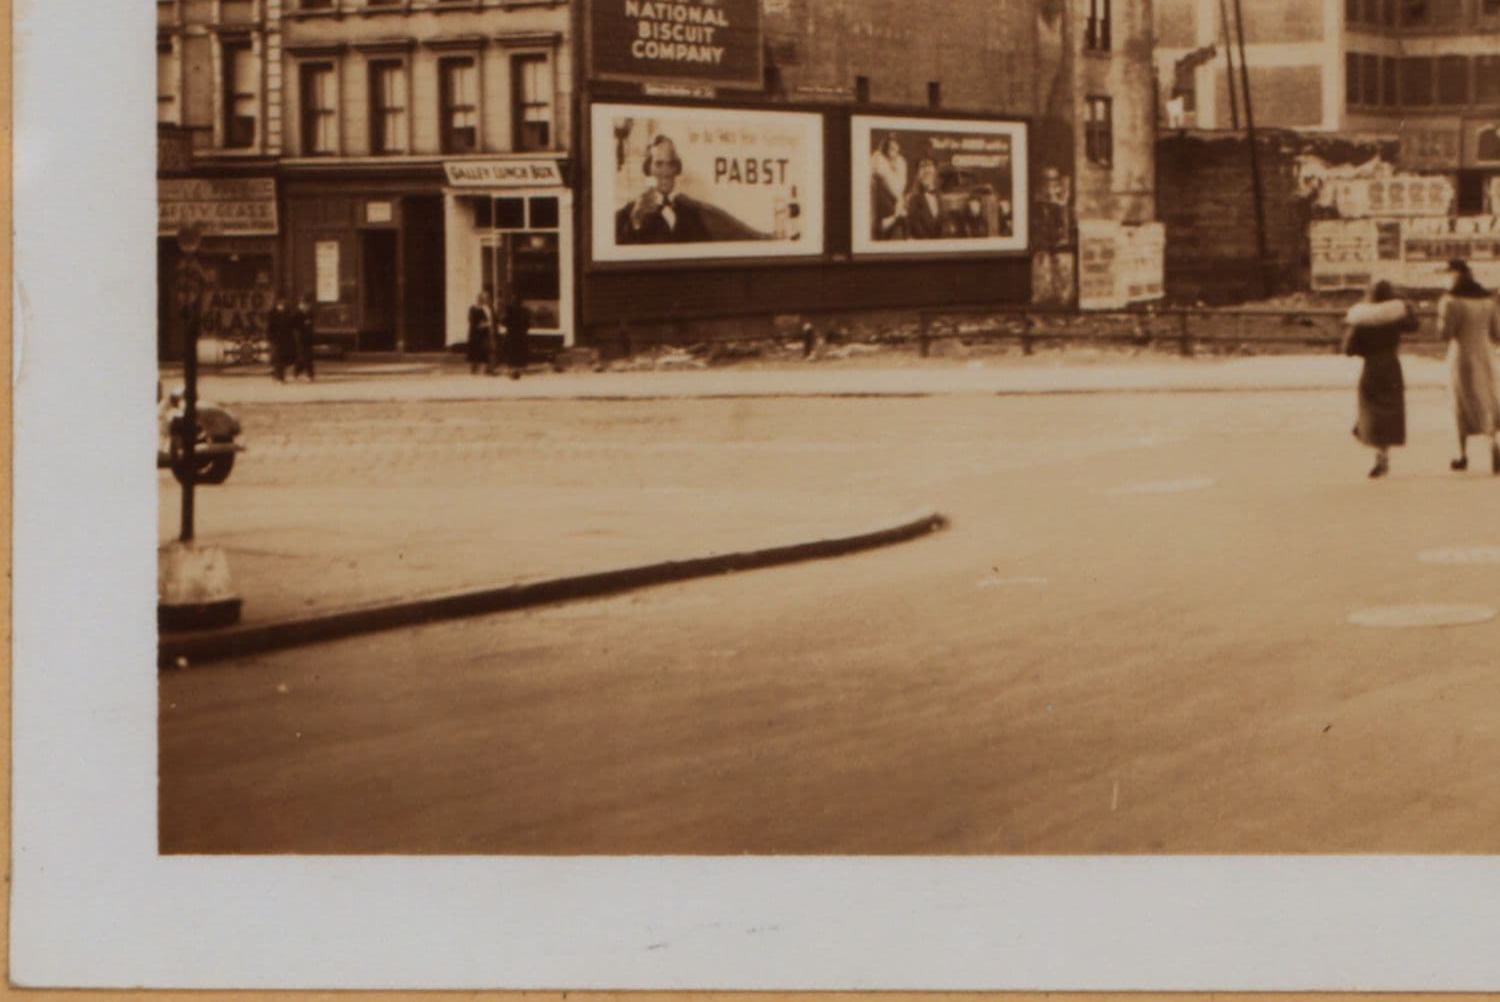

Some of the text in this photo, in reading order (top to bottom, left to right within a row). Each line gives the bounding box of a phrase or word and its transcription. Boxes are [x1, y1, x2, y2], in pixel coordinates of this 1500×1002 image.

[624, 0, 730, 27] NATIONAL
[638, 20, 716, 45] BISCUIT
[631, 39, 725, 64] COMPANY
[714, 156, 790, 185] PABST
[210, 290, 265, 310] AUTO
